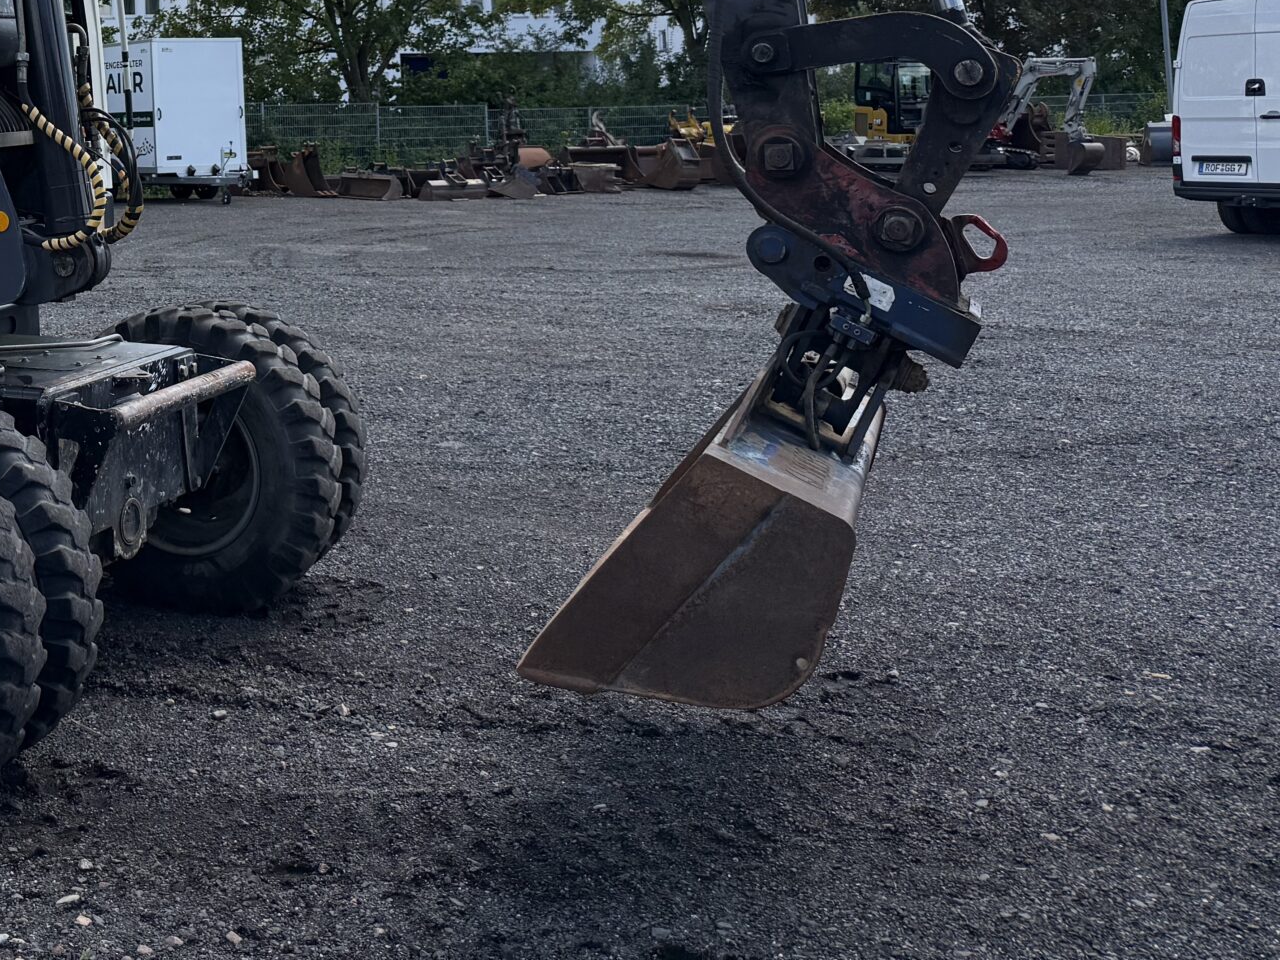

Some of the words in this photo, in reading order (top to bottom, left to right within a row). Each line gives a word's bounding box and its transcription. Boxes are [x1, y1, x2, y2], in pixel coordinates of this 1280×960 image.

[1204, 164, 1220, 172] ROF
[1224, 164, 1236, 172] GG
[1238, 164, 1242, 172] 7
